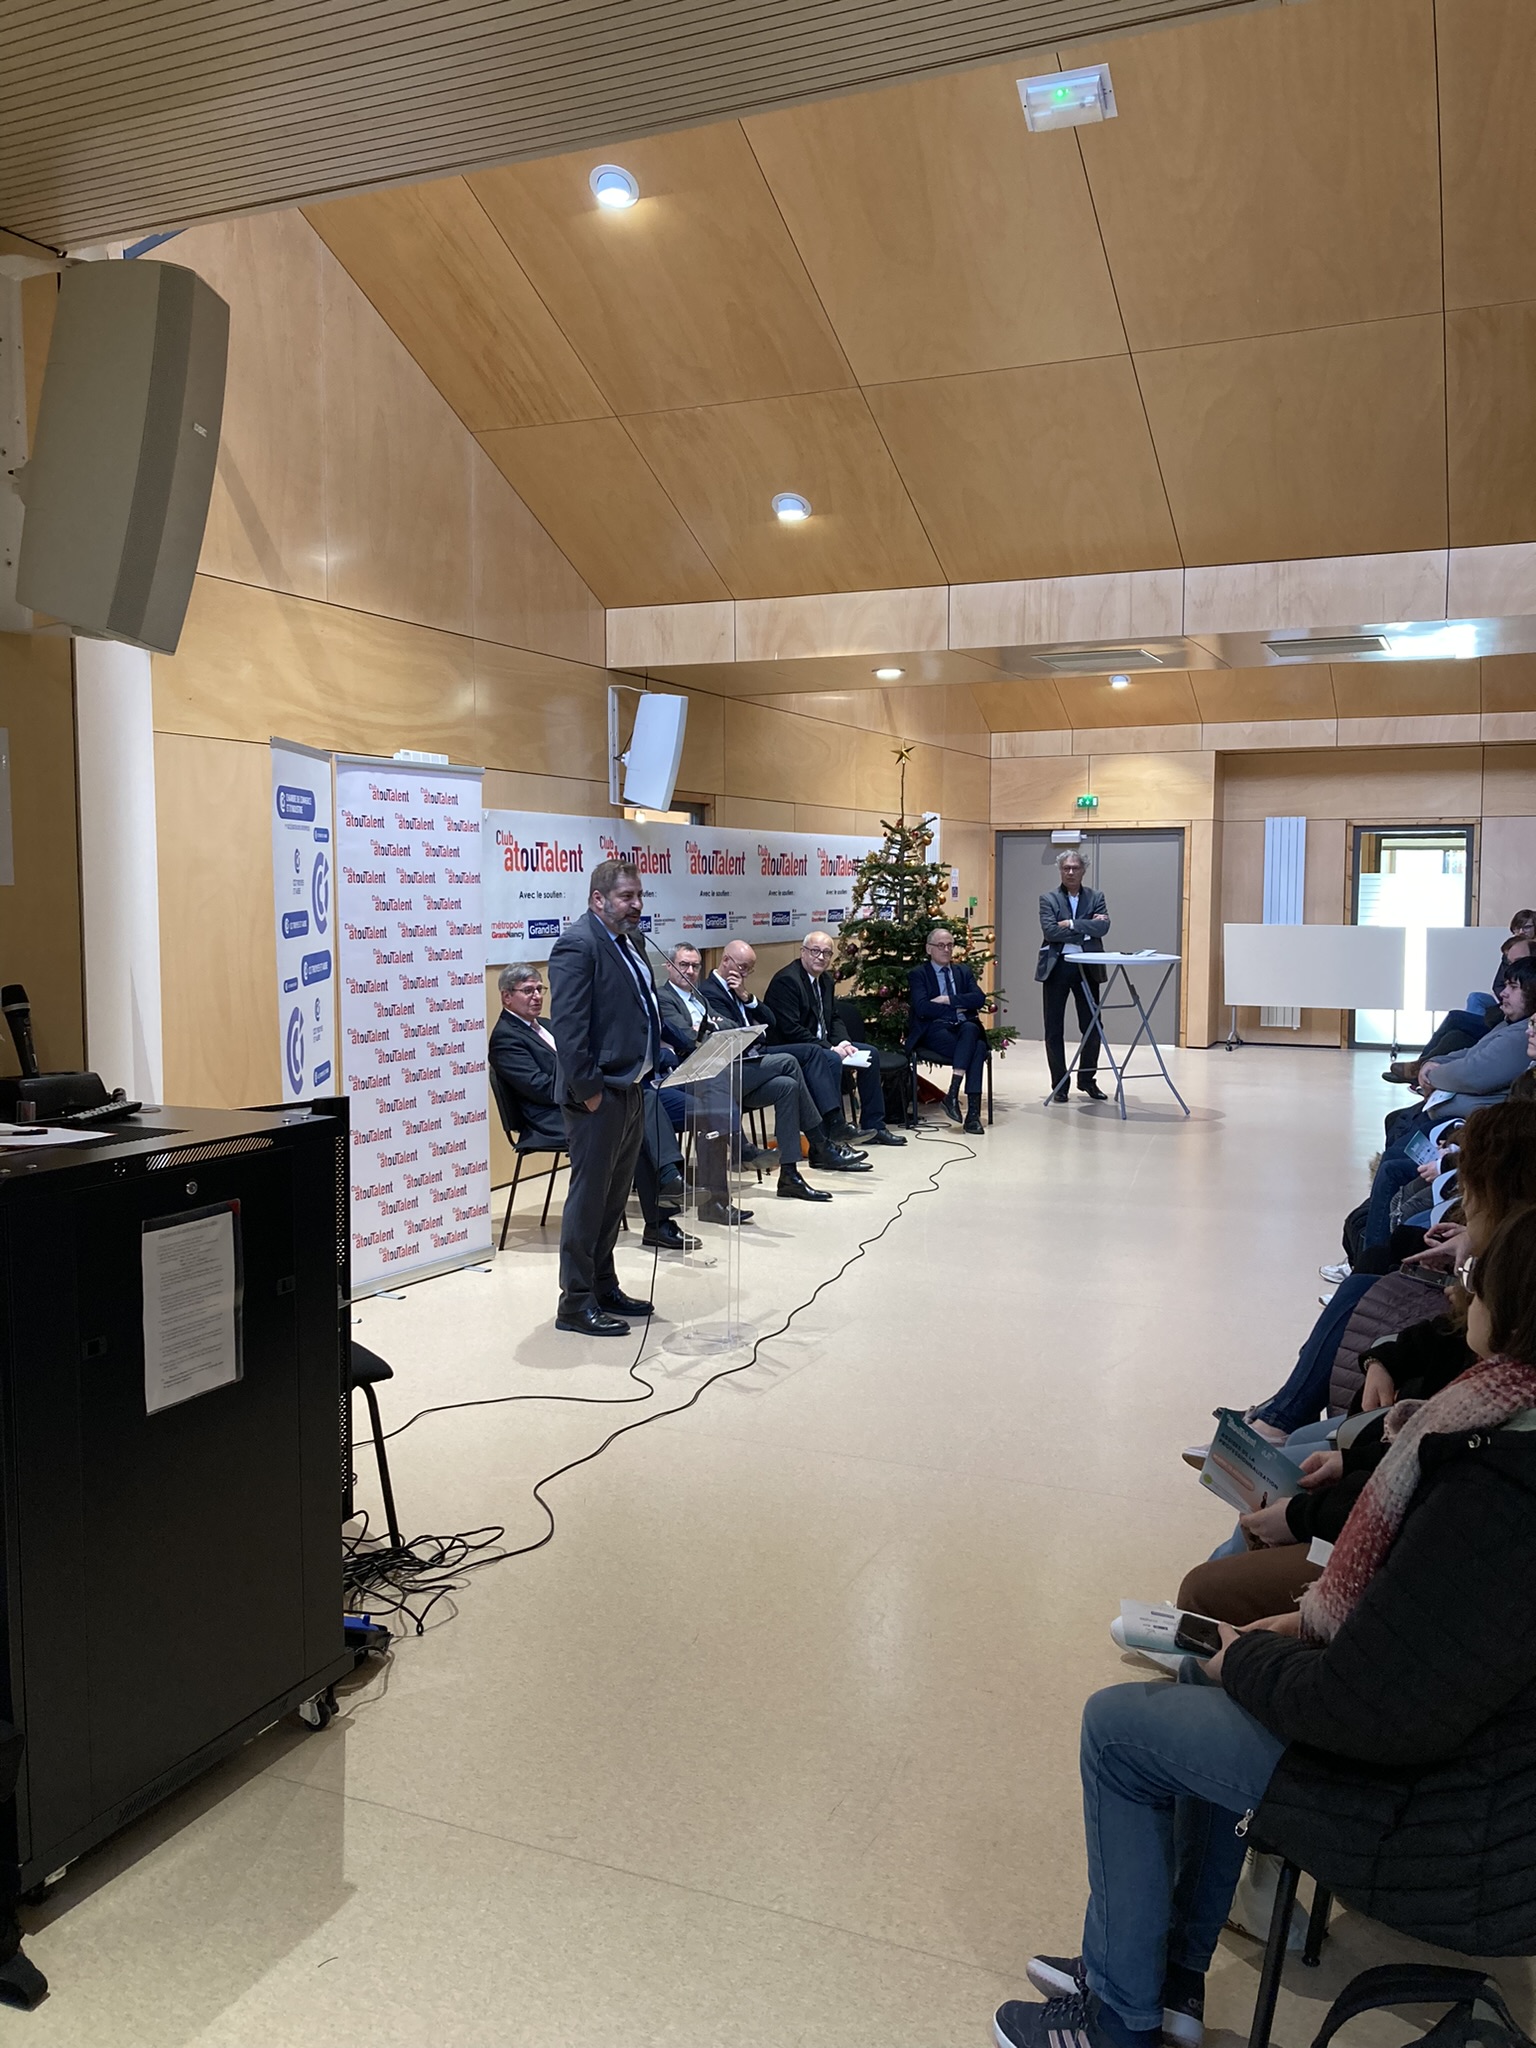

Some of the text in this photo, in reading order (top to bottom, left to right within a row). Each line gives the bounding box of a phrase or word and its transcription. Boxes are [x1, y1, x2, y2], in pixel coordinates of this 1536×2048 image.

[372, 789, 409, 802] atouTalent
[424, 792, 458, 805] atouTalent
[346, 815, 384, 828] atouTalent
[398, 818, 434, 830] atouTalent
[447, 820, 480, 832] atouTalent
[496, 830, 514, 845] Club
[600, 836, 614, 849] Club
[374, 844, 410, 857] atouTalent
[425, 845, 460, 857] atouTalent
[685, 841, 698, 853] Club
[758, 845, 768, 856] Club
[504, 841, 584, 872] atouTalent
[691, 850, 745, 875] atouTalent
[761, 852, 807, 876] atouTalent
[348, 870, 386, 883] atouTalent
[400, 871, 436, 884] atouTalent
[448, 872, 480, 884] atouTalent
[375, 898, 412, 911] atouTalent
[427, 898, 461, 910] atouTalent
[401, 925, 437, 938] atouTalent
[450, 923, 482, 936] atouTalent
[491, 920, 524, 930] métropole
[349, 927, 387, 939] atouTalent
[376, 951, 413, 964] atouTalent
[428, 948, 463, 961] atouTalent
[350, 979, 388, 994] atouTalent
[403, 976, 438, 990] atouTalent
[451, 973, 483, 986] atouTalent
[377, 1003, 414, 1018] atouTalent
[430, 998, 464, 1012] atouTalent
[404, 1024, 440, 1038] atouTalent
[452, 1018, 484, 1033] atouTalent
[352, 1029, 389, 1044] atouTalent
[378, 1048, 416, 1064] atouTalent
[430, 1042, 465, 1057] atouTalent
[405, 1067, 440, 1083] atouTalent
[453, 1061, 485, 1076] atouTalent
[353, 1074, 390, 1091] atouTalent
[431, 1088, 465, 1105] atouTalent
[379, 1097, 417, 1114] atouTalent
[454, 1110, 486, 1126] atouTalent
[405, 1118, 442, 1136] atouTalent
[354, 1127, 392, 1145] atouTalent
[432, 1139, 466, 1157] atouTalent
[380, 1150, 418, 1168] atouTalent
[455, 1160, 488, 1178] atouTalent
[407, 1170, 442, 1189] atouTalent
[355, 1182, 393, 1201] atouTalent
[433, 1184, 467, 1203] atouTalent
[381, 1196, 418, 1216] atouTalent
[456, 1203, 488, 1222] atouTalent
[408, 1215, 443, 1235] atouTalent
[356, 1228, 394, 1249] atouTalent
[434, 1229, 468, 1248] atouTalent
[382, 1242, 419, 1263] atouTalent
